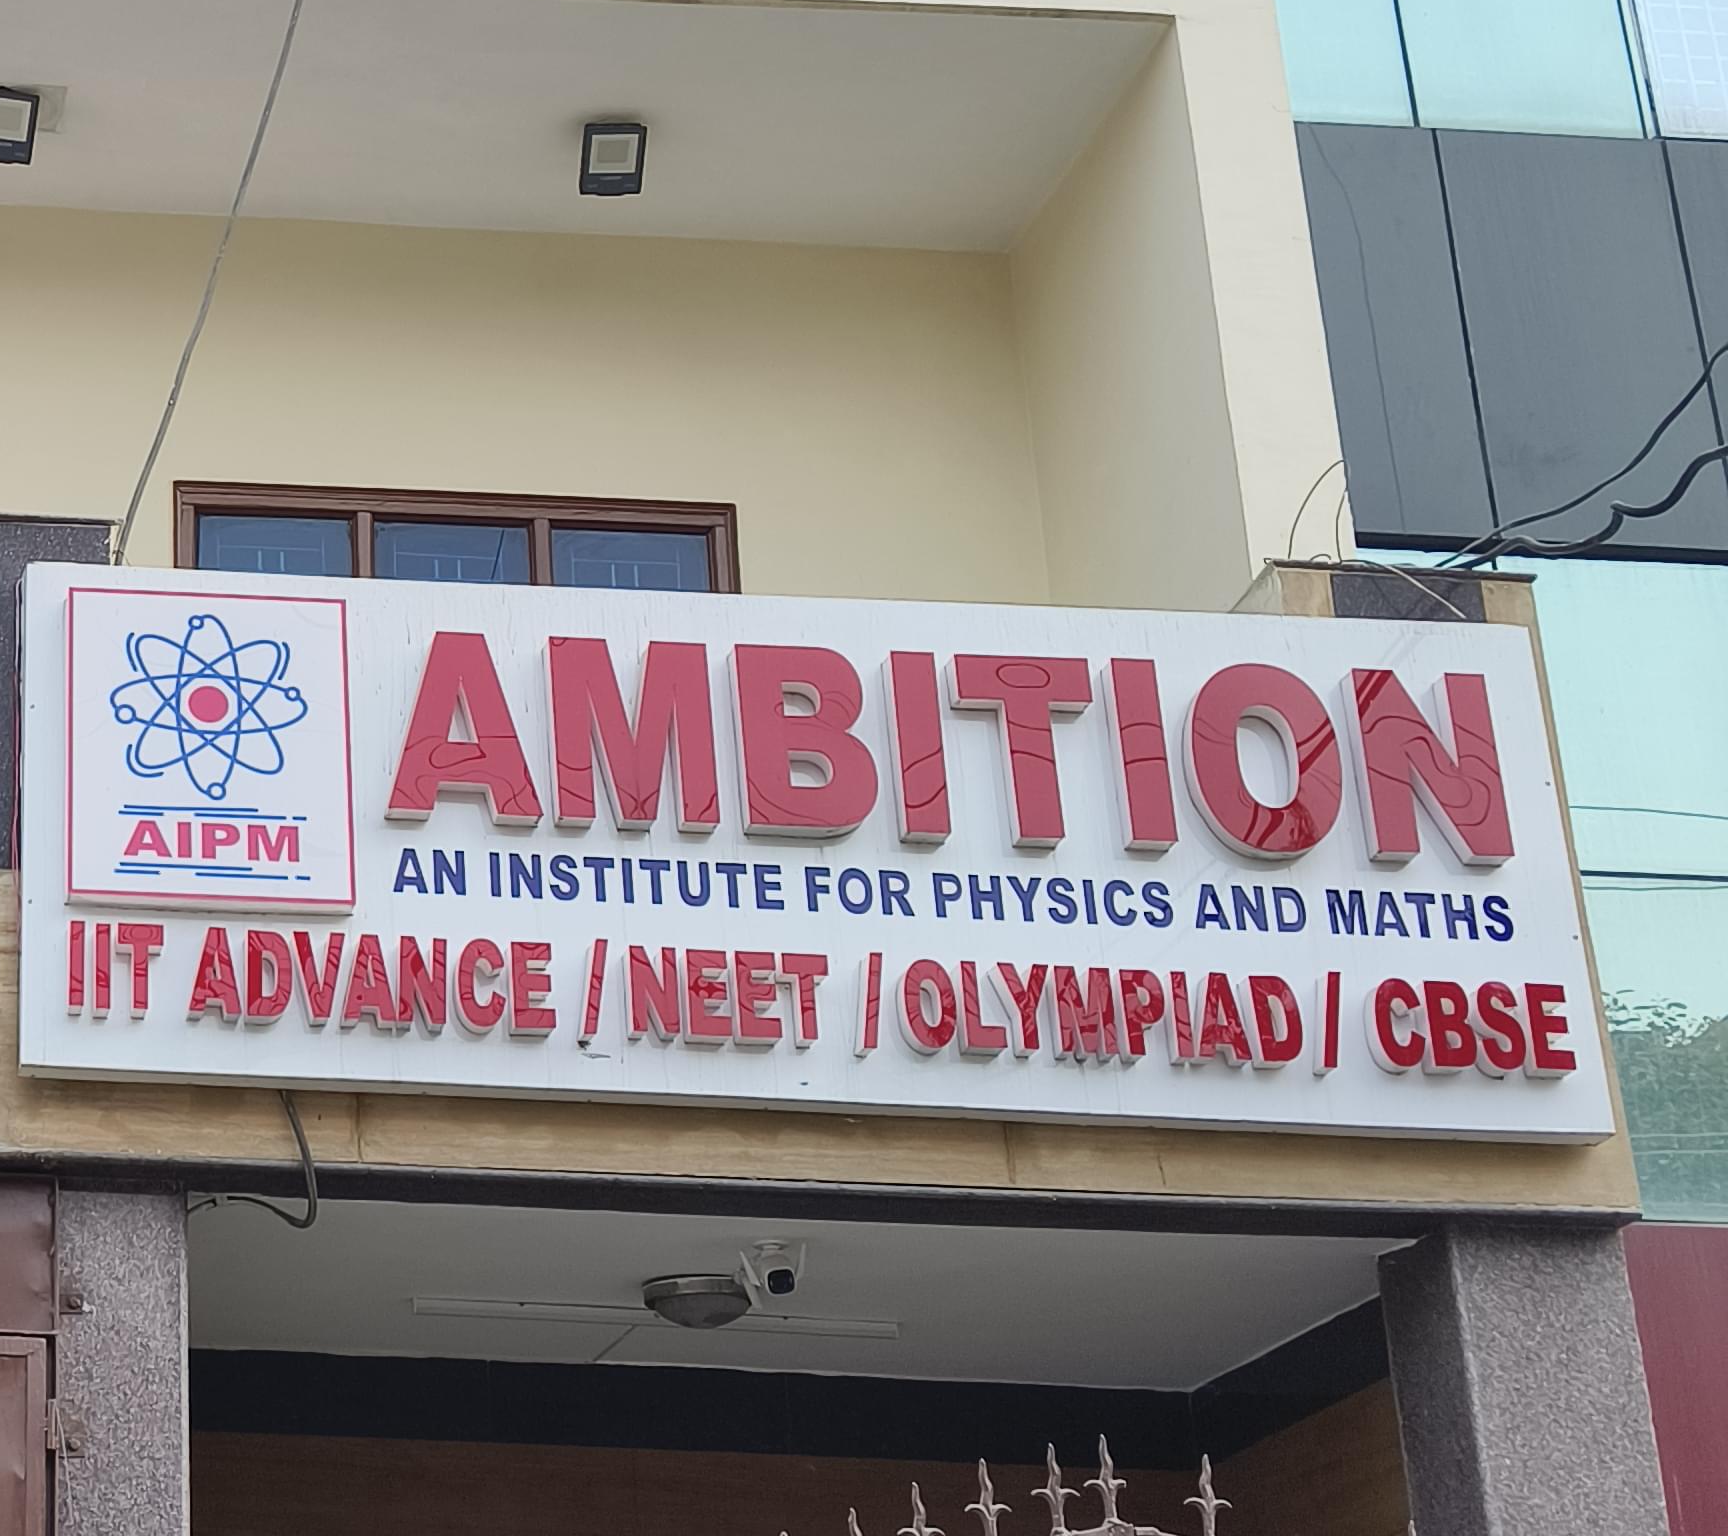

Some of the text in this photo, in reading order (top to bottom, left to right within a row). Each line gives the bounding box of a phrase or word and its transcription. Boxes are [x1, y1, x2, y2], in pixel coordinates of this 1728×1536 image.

[385, 631, 1515, 866] AMBITION
[123, 819, 300, 863] AIPM
[393, 848, 1515, 942] AN INSTITUTE FOR PHYSICS AND MATHS
[67, 920, 164, 1019] IIT
[187, 927, 557, 1037] ADVANCE
[624, 945, 827, 1049] NEET
[898, 958, 1303, 1070] OLYMPIAD
[1367, 978, 1577, 1081] CBSE
